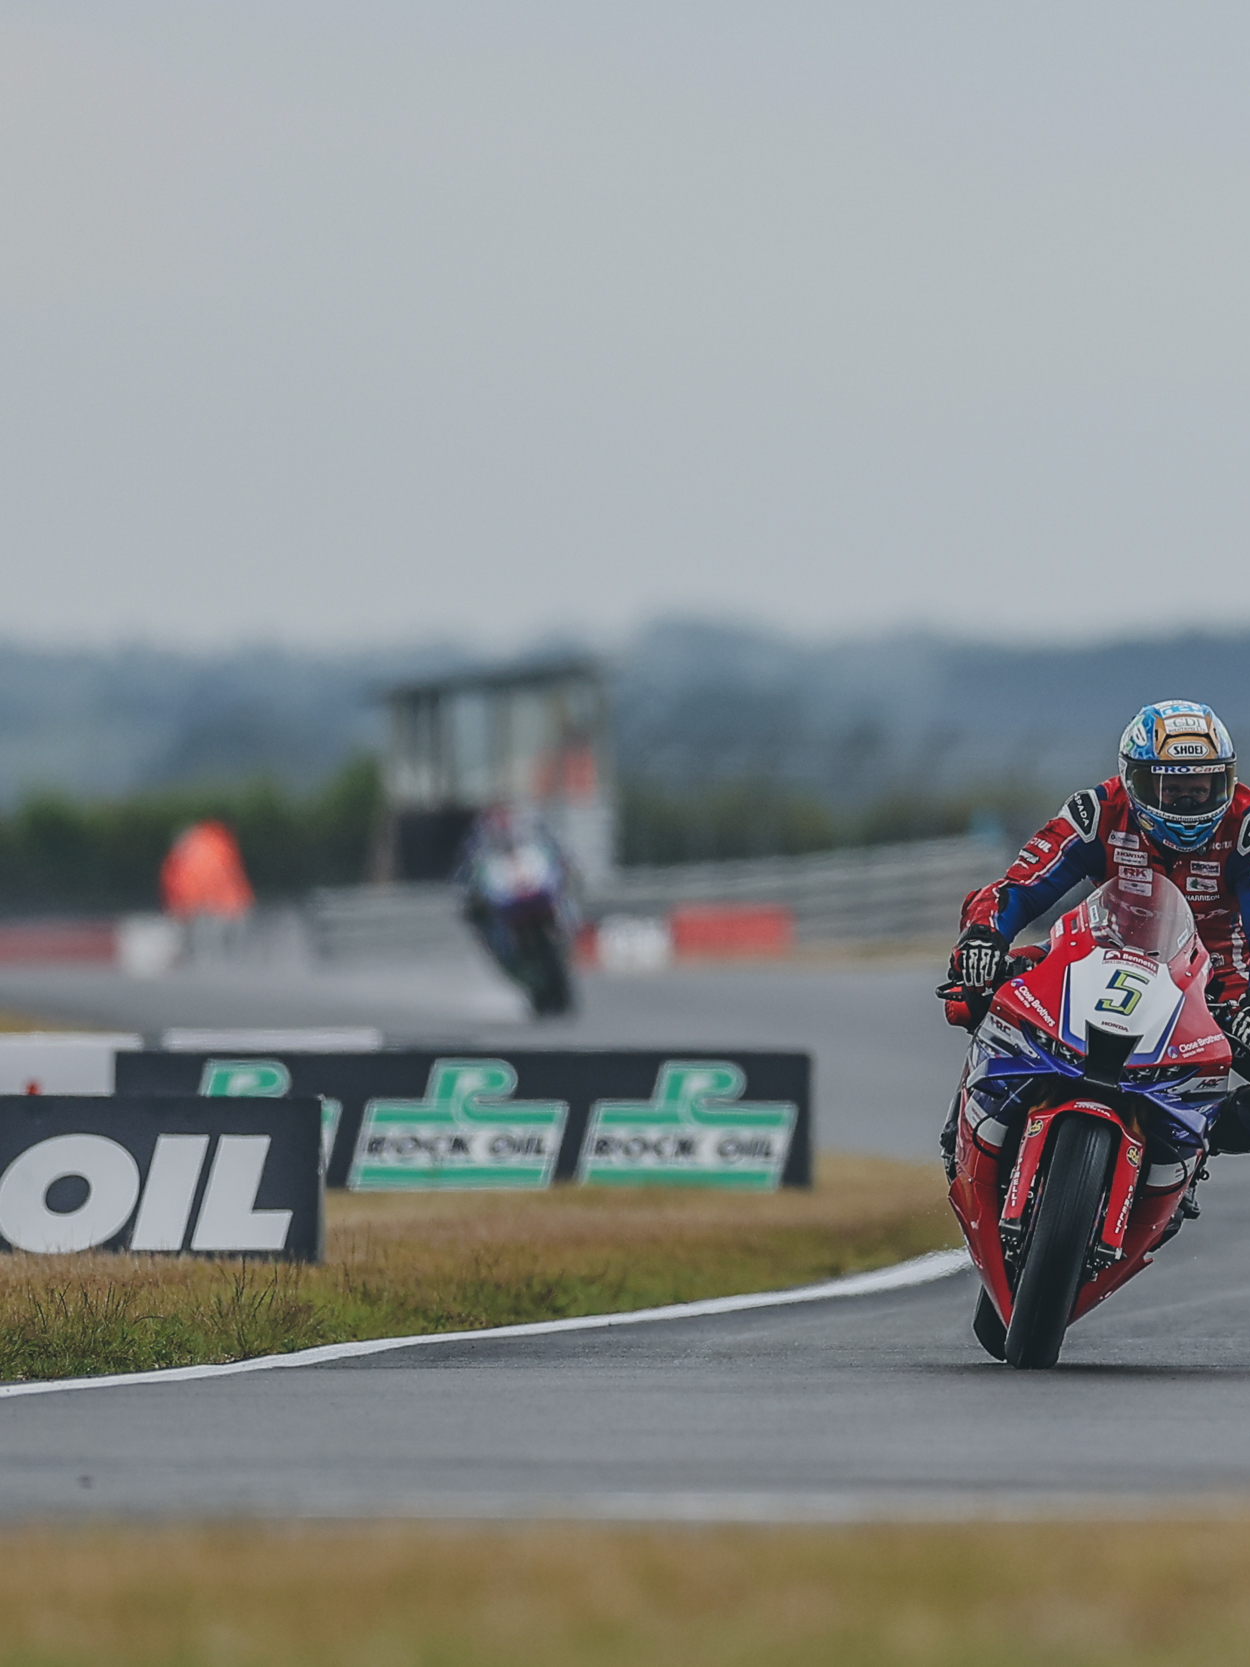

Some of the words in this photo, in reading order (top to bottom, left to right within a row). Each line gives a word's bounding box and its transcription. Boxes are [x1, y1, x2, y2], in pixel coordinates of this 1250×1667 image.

[1173, 745, 1204, 755] SHOEI
[1074, 793, 1090, 827] SPADA
[1030, 837, 1052, 853] OTUL
[1124, 867, 1147, 878] RK
[1123, 953, 1157, 971] Bennetts
[1094, 969, 1150, 1016] 5
[1018, 986, 1035, 1002] Close
[1031, 999, 1056, 1027] Brothers
[1101, 1021, 1129, 1033] HONDA
[1178, 1041, 1198, 1053] Close
[1196, 1033, 1226, 1047] Brothers
[0, 1133, 294, 1254] OIL
